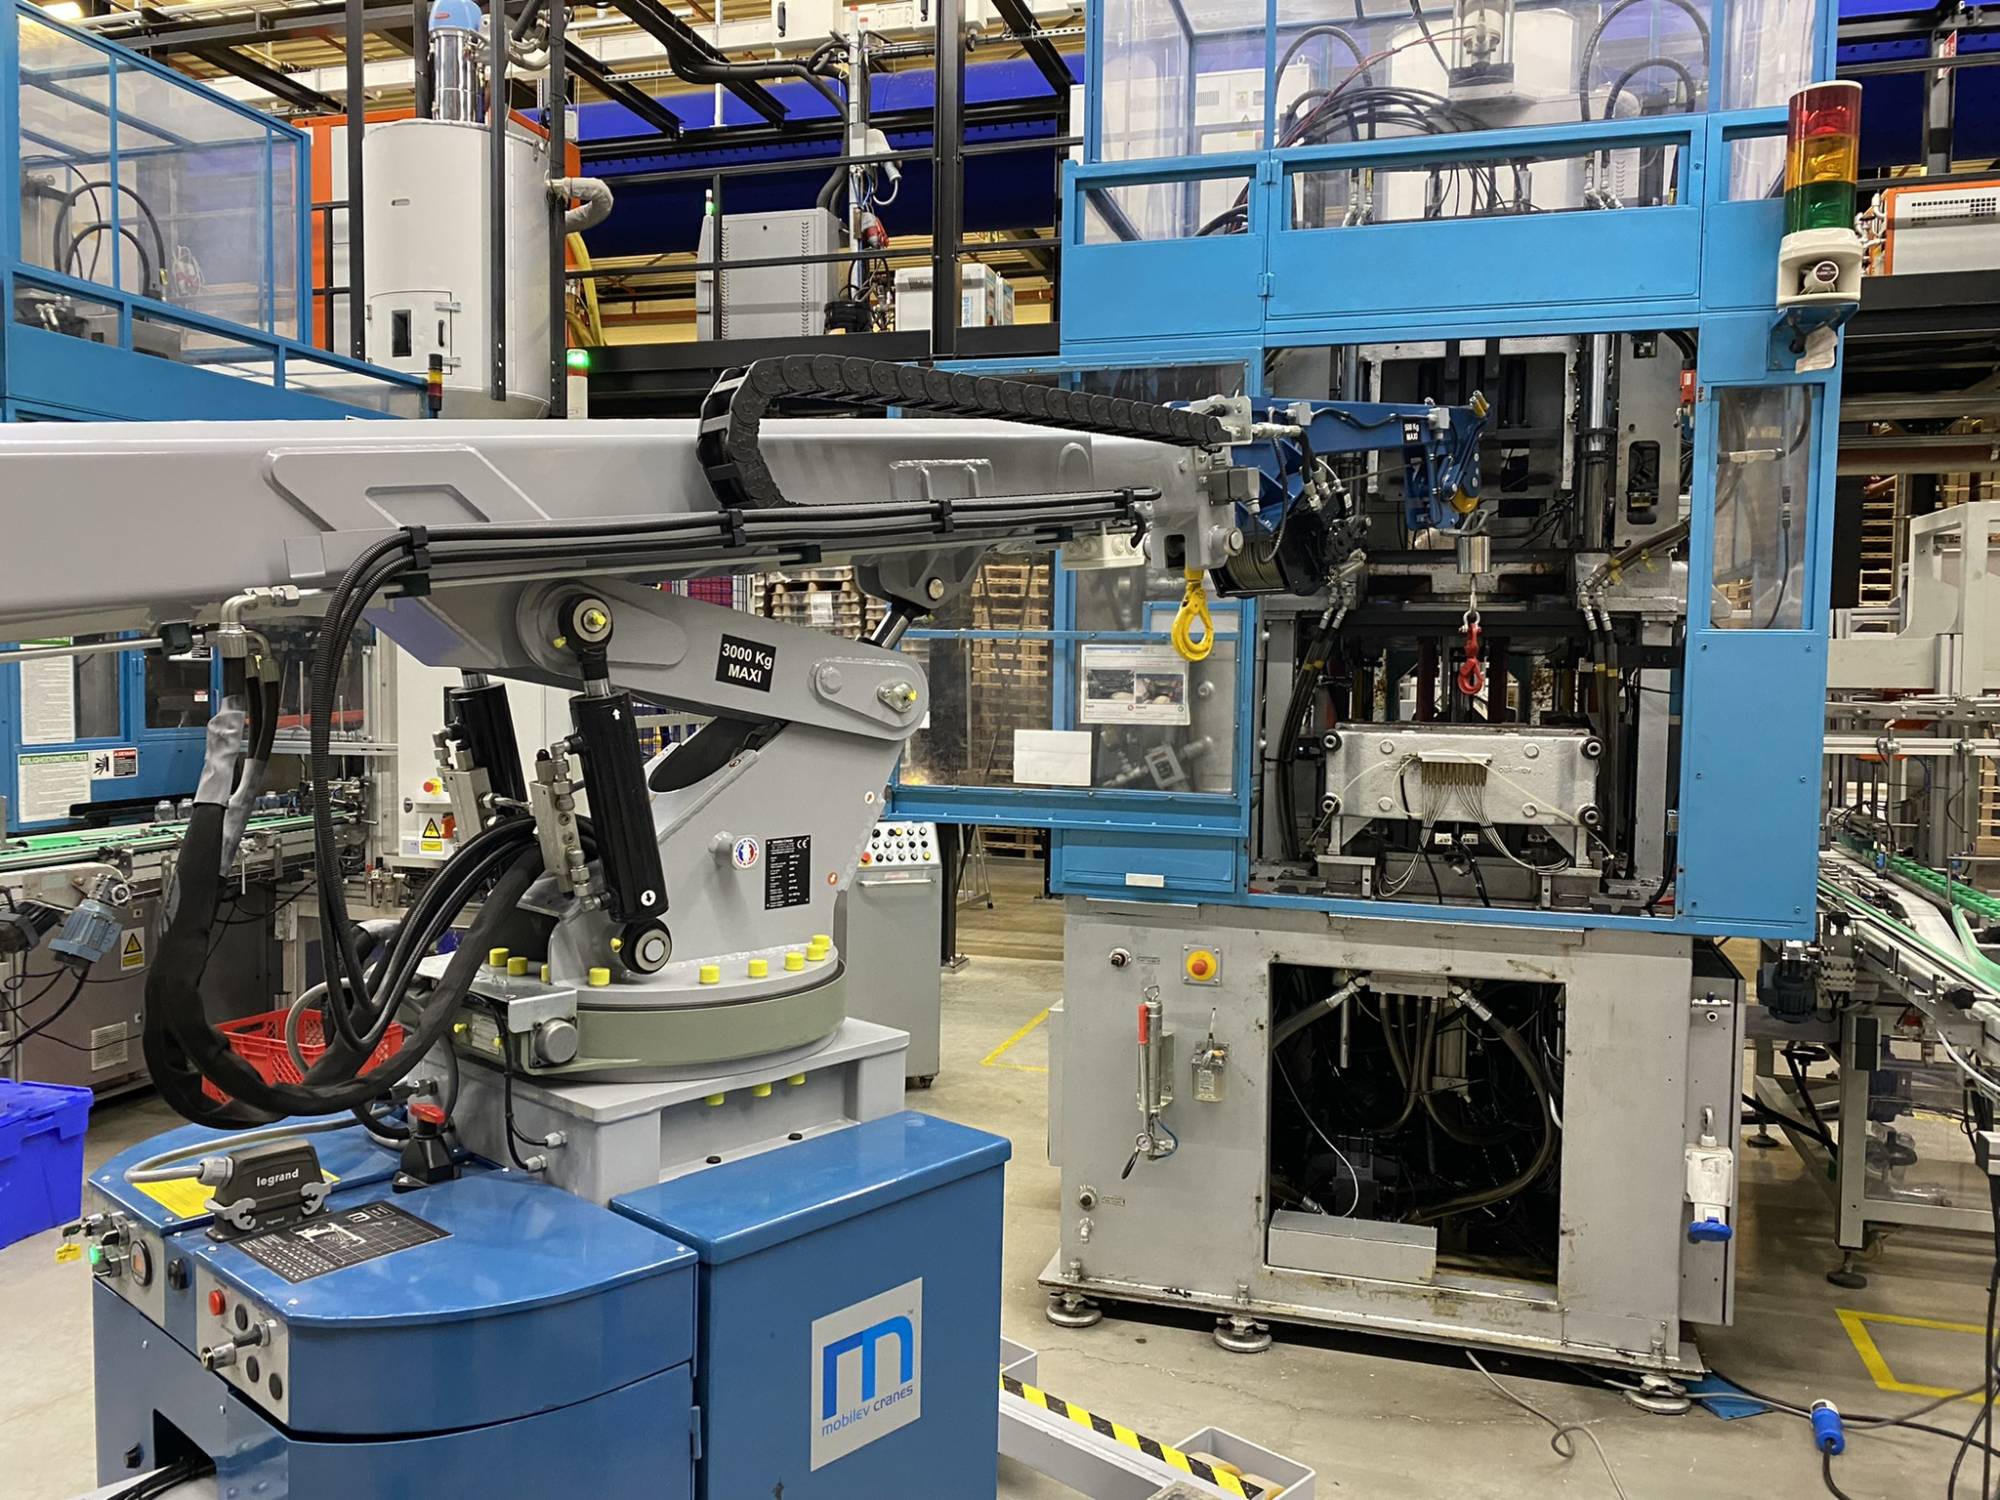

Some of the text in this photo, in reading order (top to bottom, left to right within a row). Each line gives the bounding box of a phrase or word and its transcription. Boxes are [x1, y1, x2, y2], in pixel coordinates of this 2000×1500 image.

[722, 643, 772, 670] 3000 Kg
[728, 663, 762, 683] MAXI
[256, 1168, 299, 1188] legrand
[873, 1385, 913, 1412] cranes
